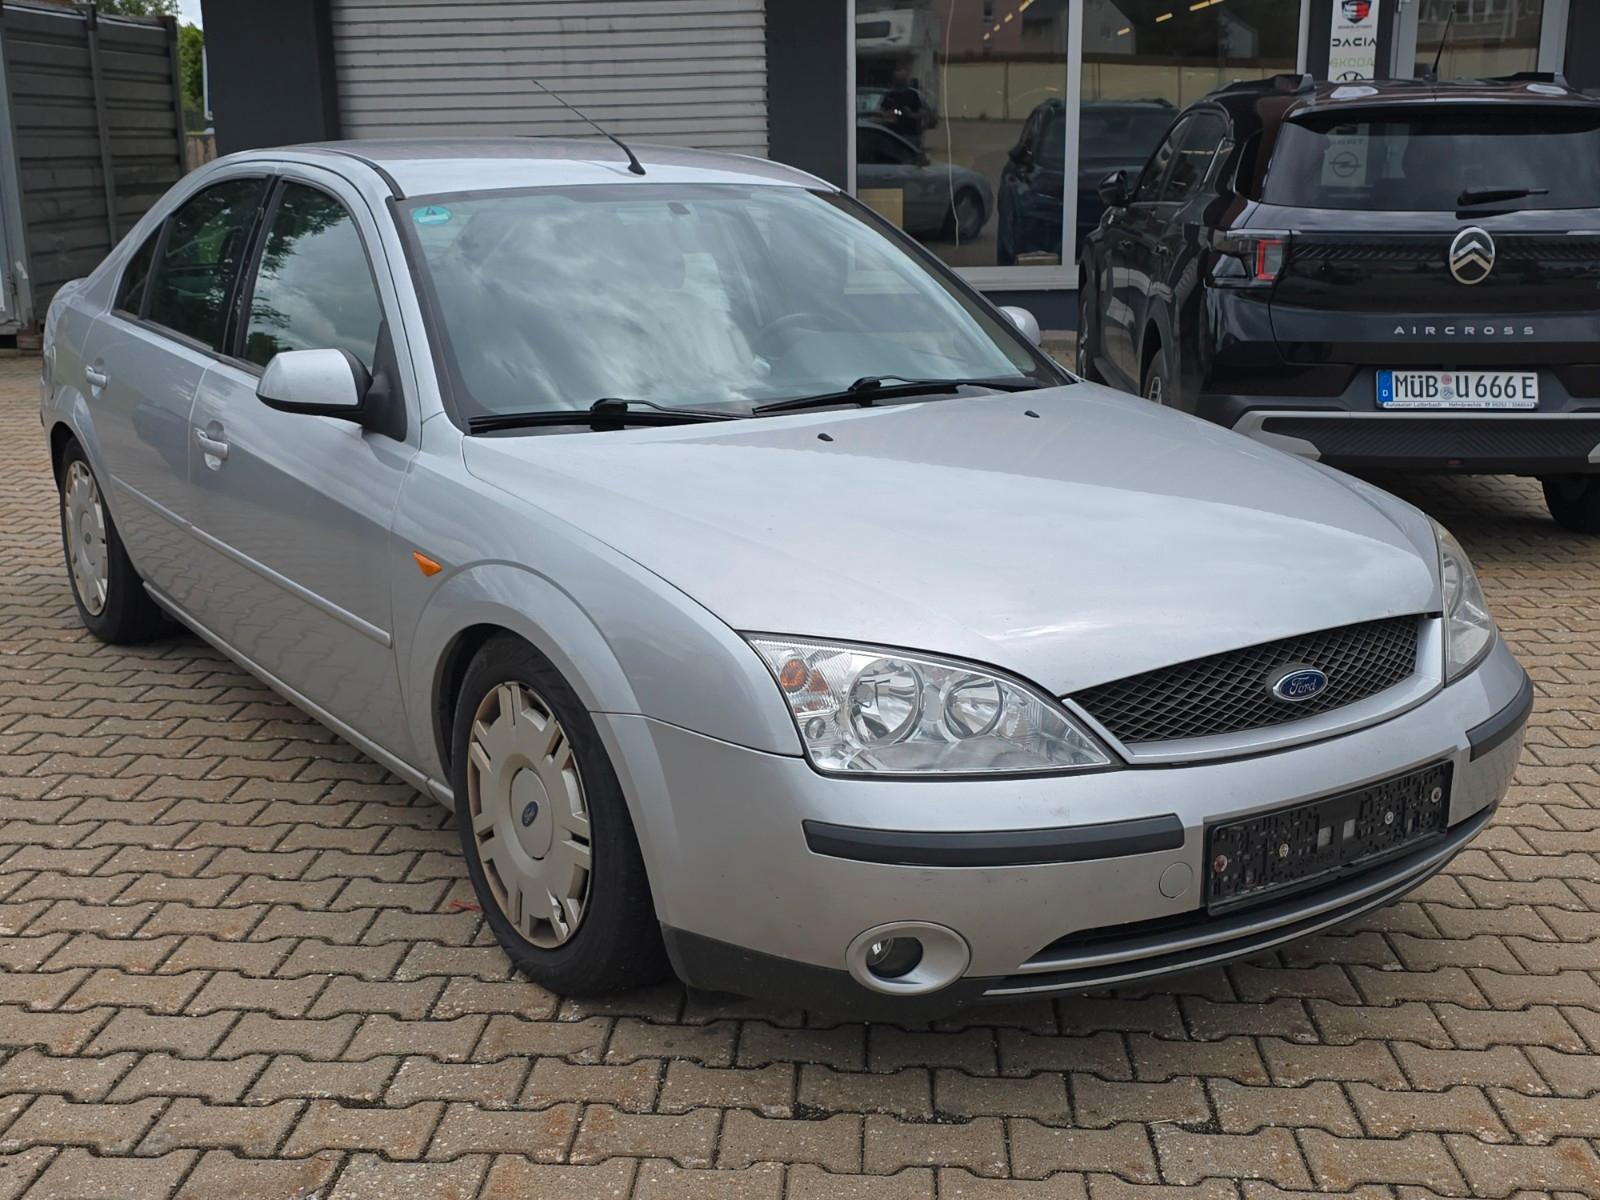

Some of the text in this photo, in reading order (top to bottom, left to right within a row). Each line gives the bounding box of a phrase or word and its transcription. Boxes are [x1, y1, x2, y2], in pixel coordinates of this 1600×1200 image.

[1332, 37, 1376, 47] DACIA
[1393, 326, 1535, 335] AIRCROSS
[1289, 675, 1317, 695] Ford
